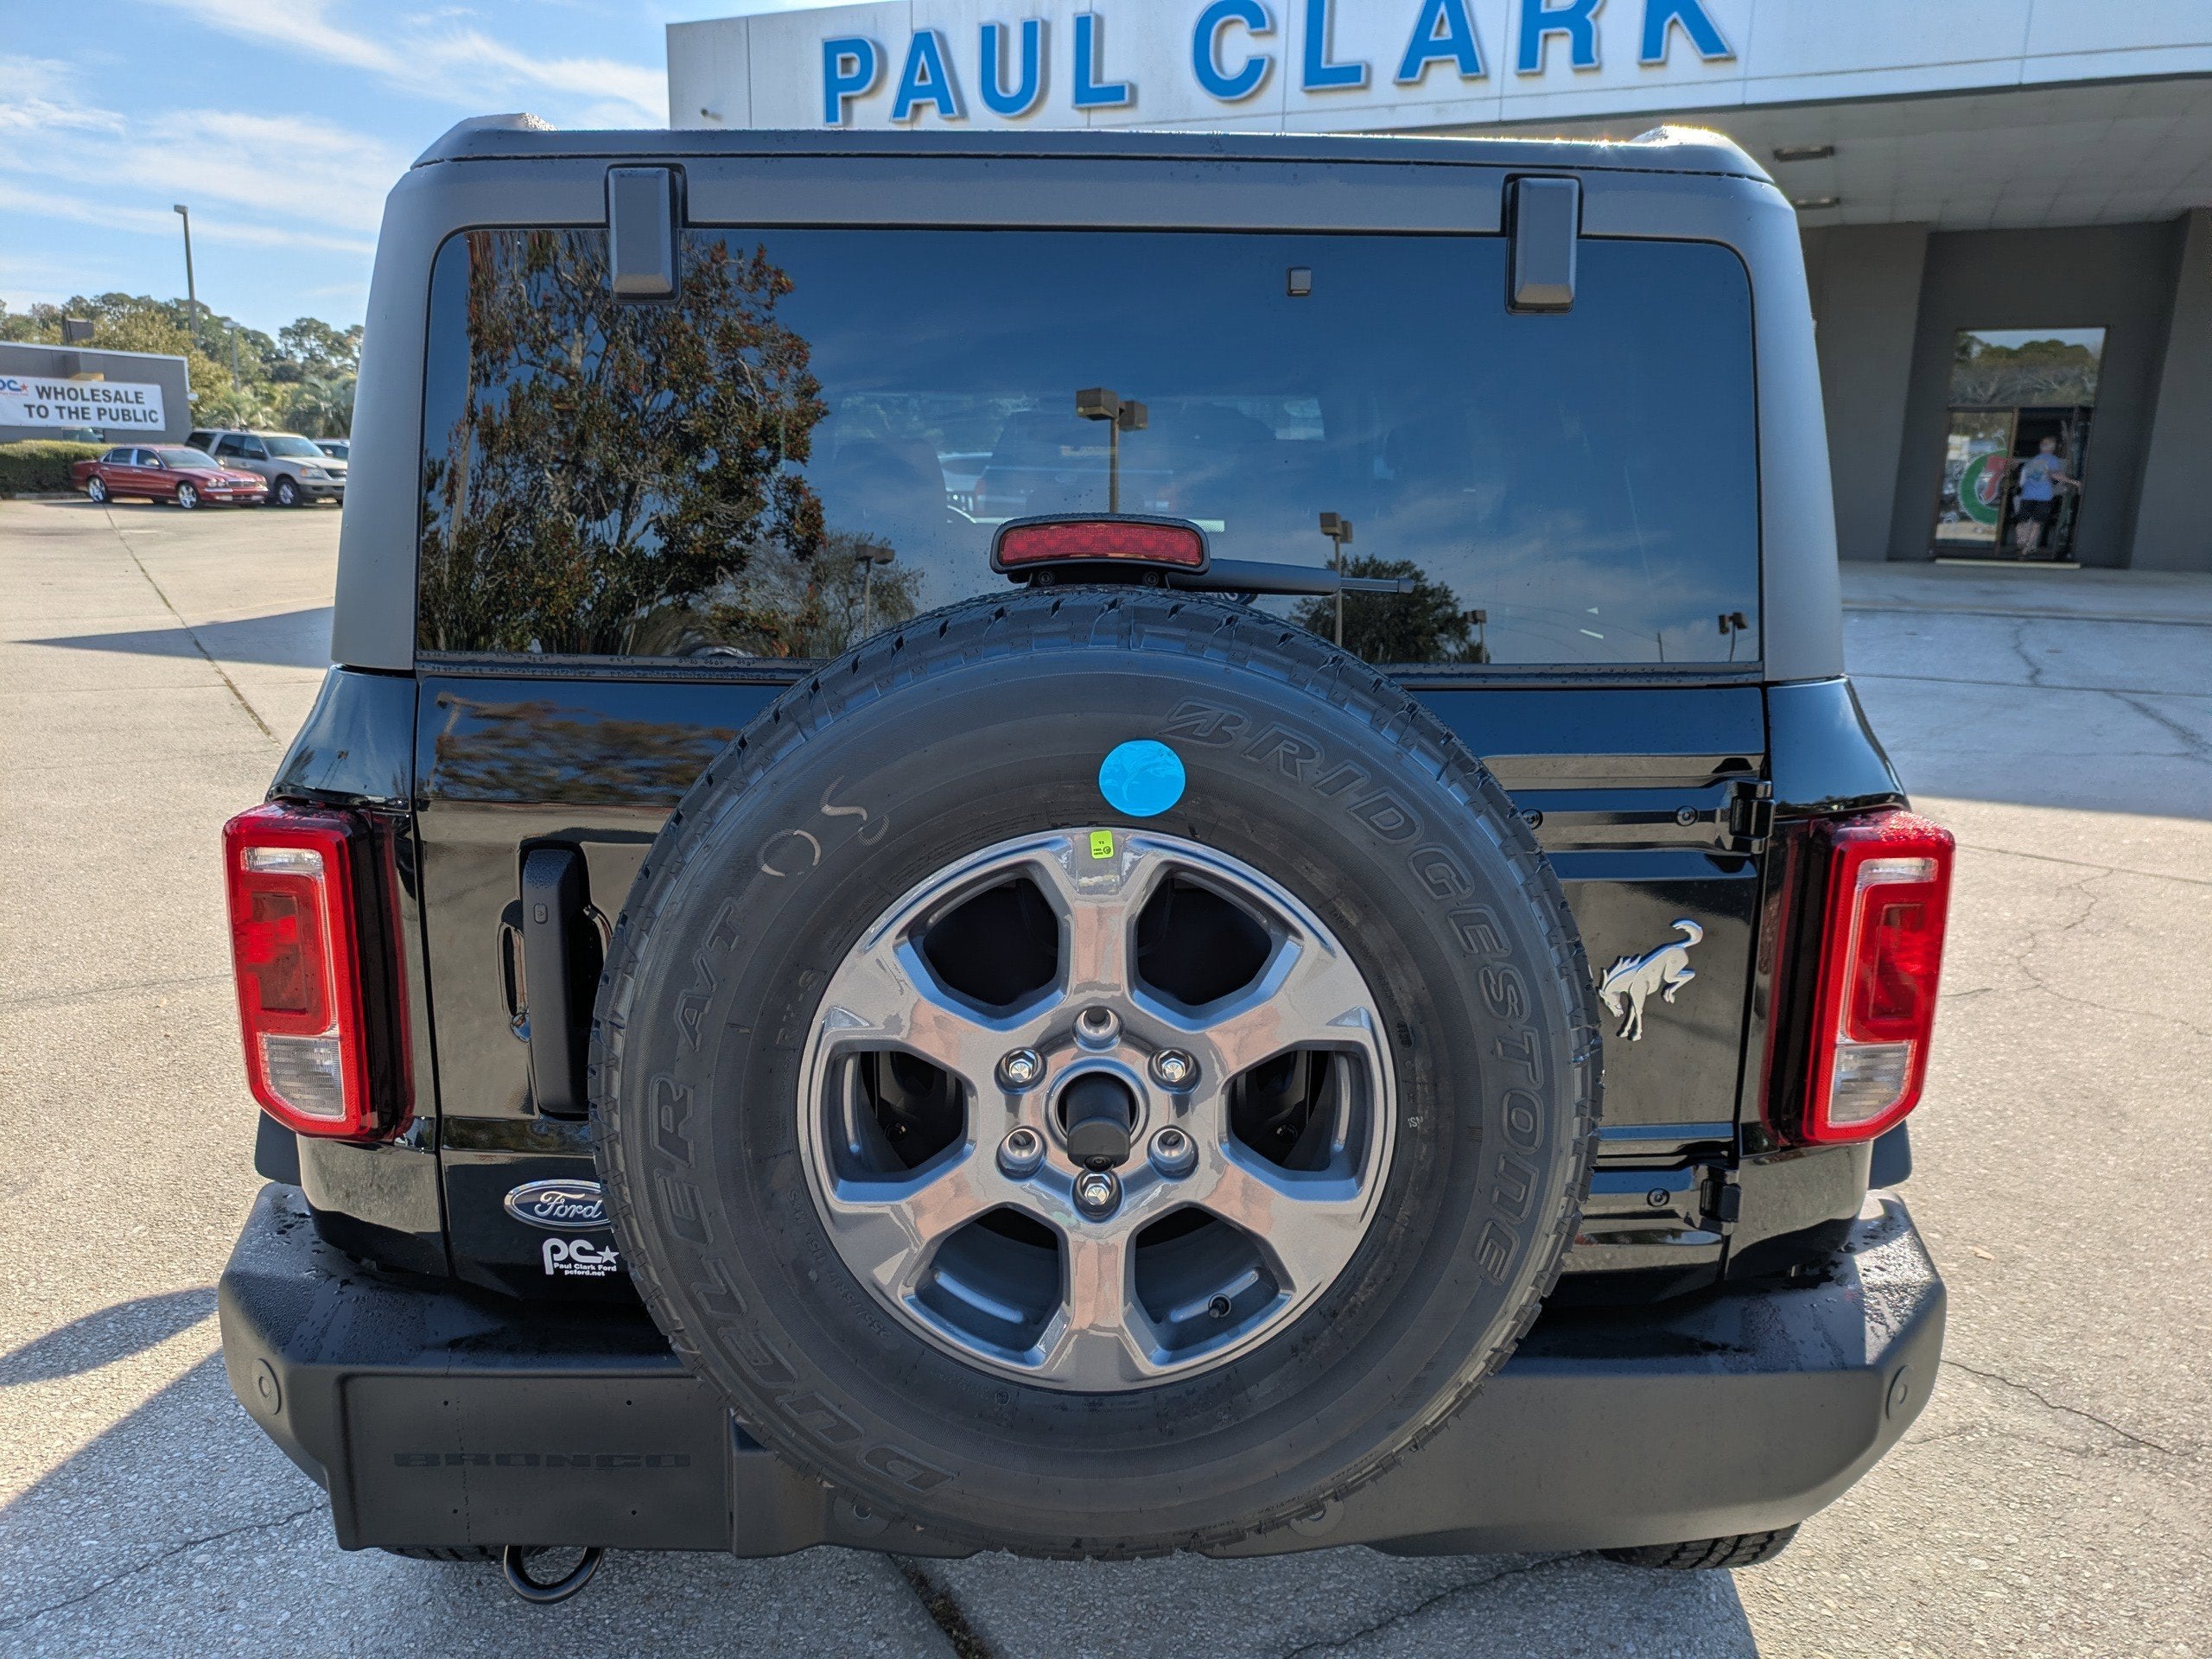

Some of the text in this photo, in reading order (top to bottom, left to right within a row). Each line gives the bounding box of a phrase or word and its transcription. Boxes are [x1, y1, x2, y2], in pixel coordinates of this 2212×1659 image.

[822, 0, 1735, 124] PAUL CLARK
[24, 404, 159, 423] TO THE PUBLIC
[35, 385, 145, 404] WHOLESALE
[1154, 696, 1545, 1286] BRIDGESTONE
[533, 1190, 604, 1219] Ford
[649, 897, 954, 1492] DUELER A/T
